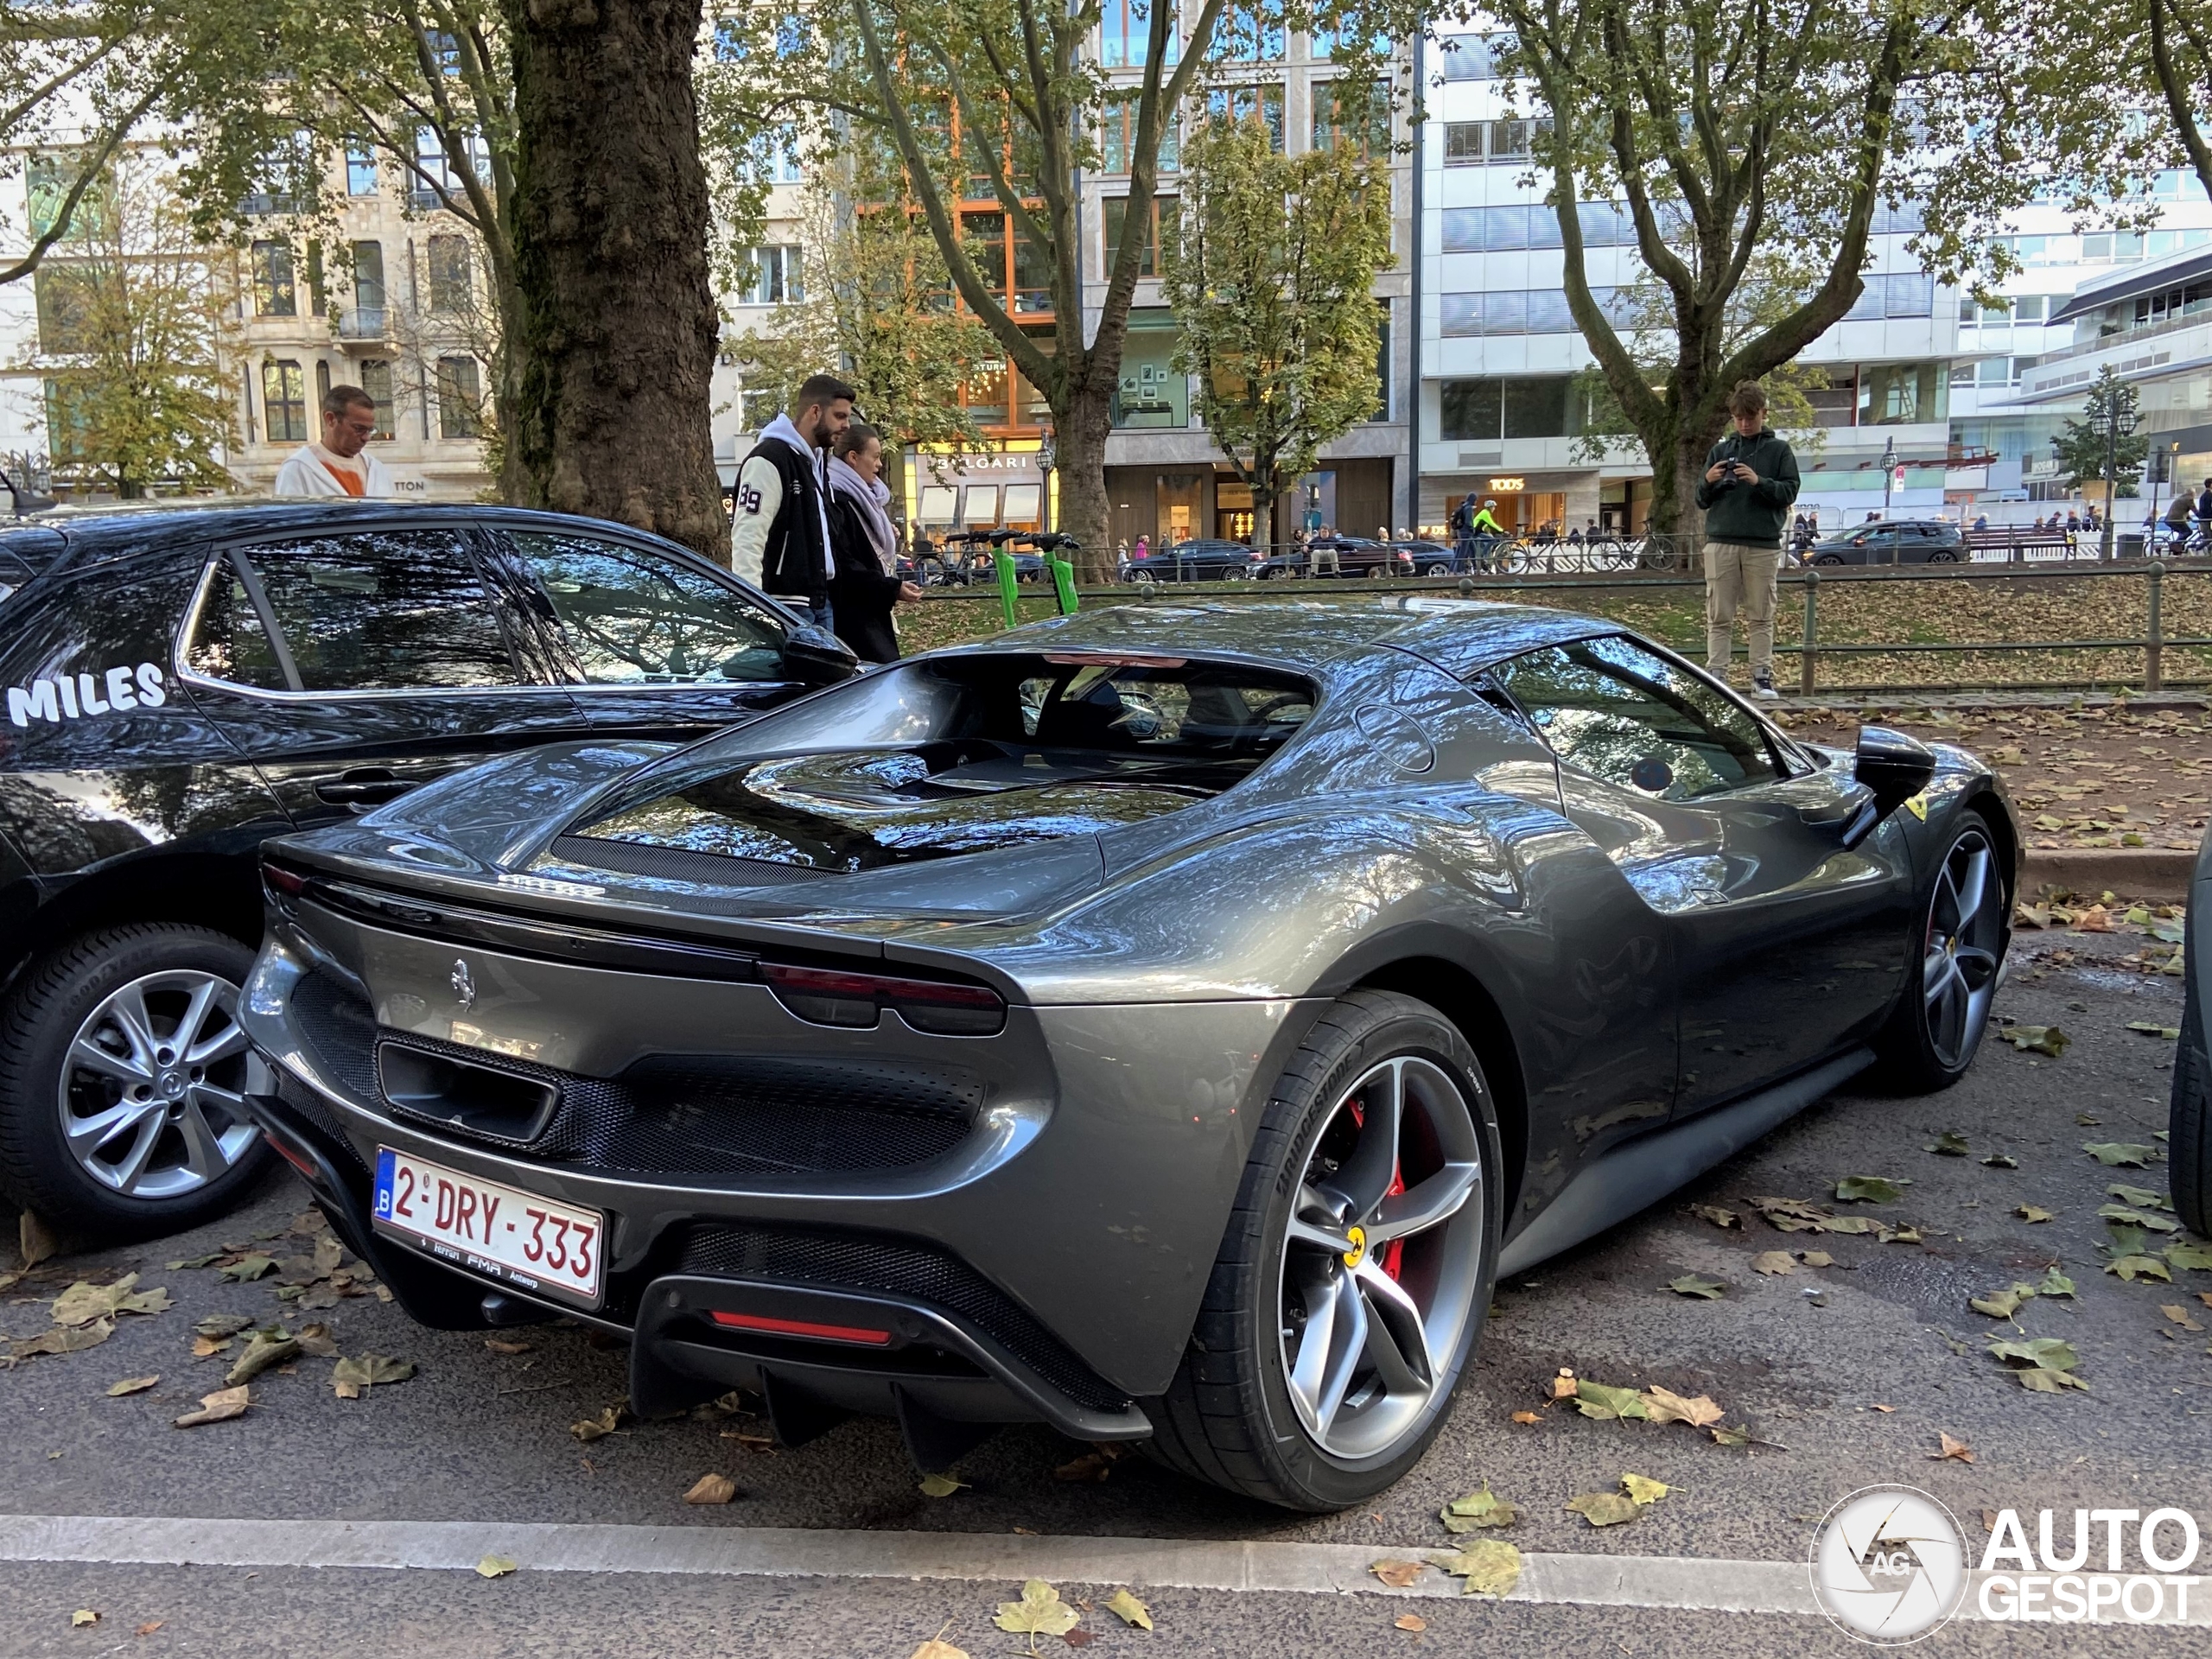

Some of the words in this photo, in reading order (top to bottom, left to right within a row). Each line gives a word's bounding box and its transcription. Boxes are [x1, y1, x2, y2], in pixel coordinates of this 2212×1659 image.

[394, 481, 424, 491] TTON
[738, 482, 762, 514] 89
[8, 662, 166, 727] MILES
[1466, 1065, 1484, 1094] SPORT
[1275, 1052, 1353, 1199] BRIDGESTONE
[378, 1189, 390, 1212] B
[434, 1243, 460, 1261] Ferrari
[509, 1270, 538, 1289] Antwerp
